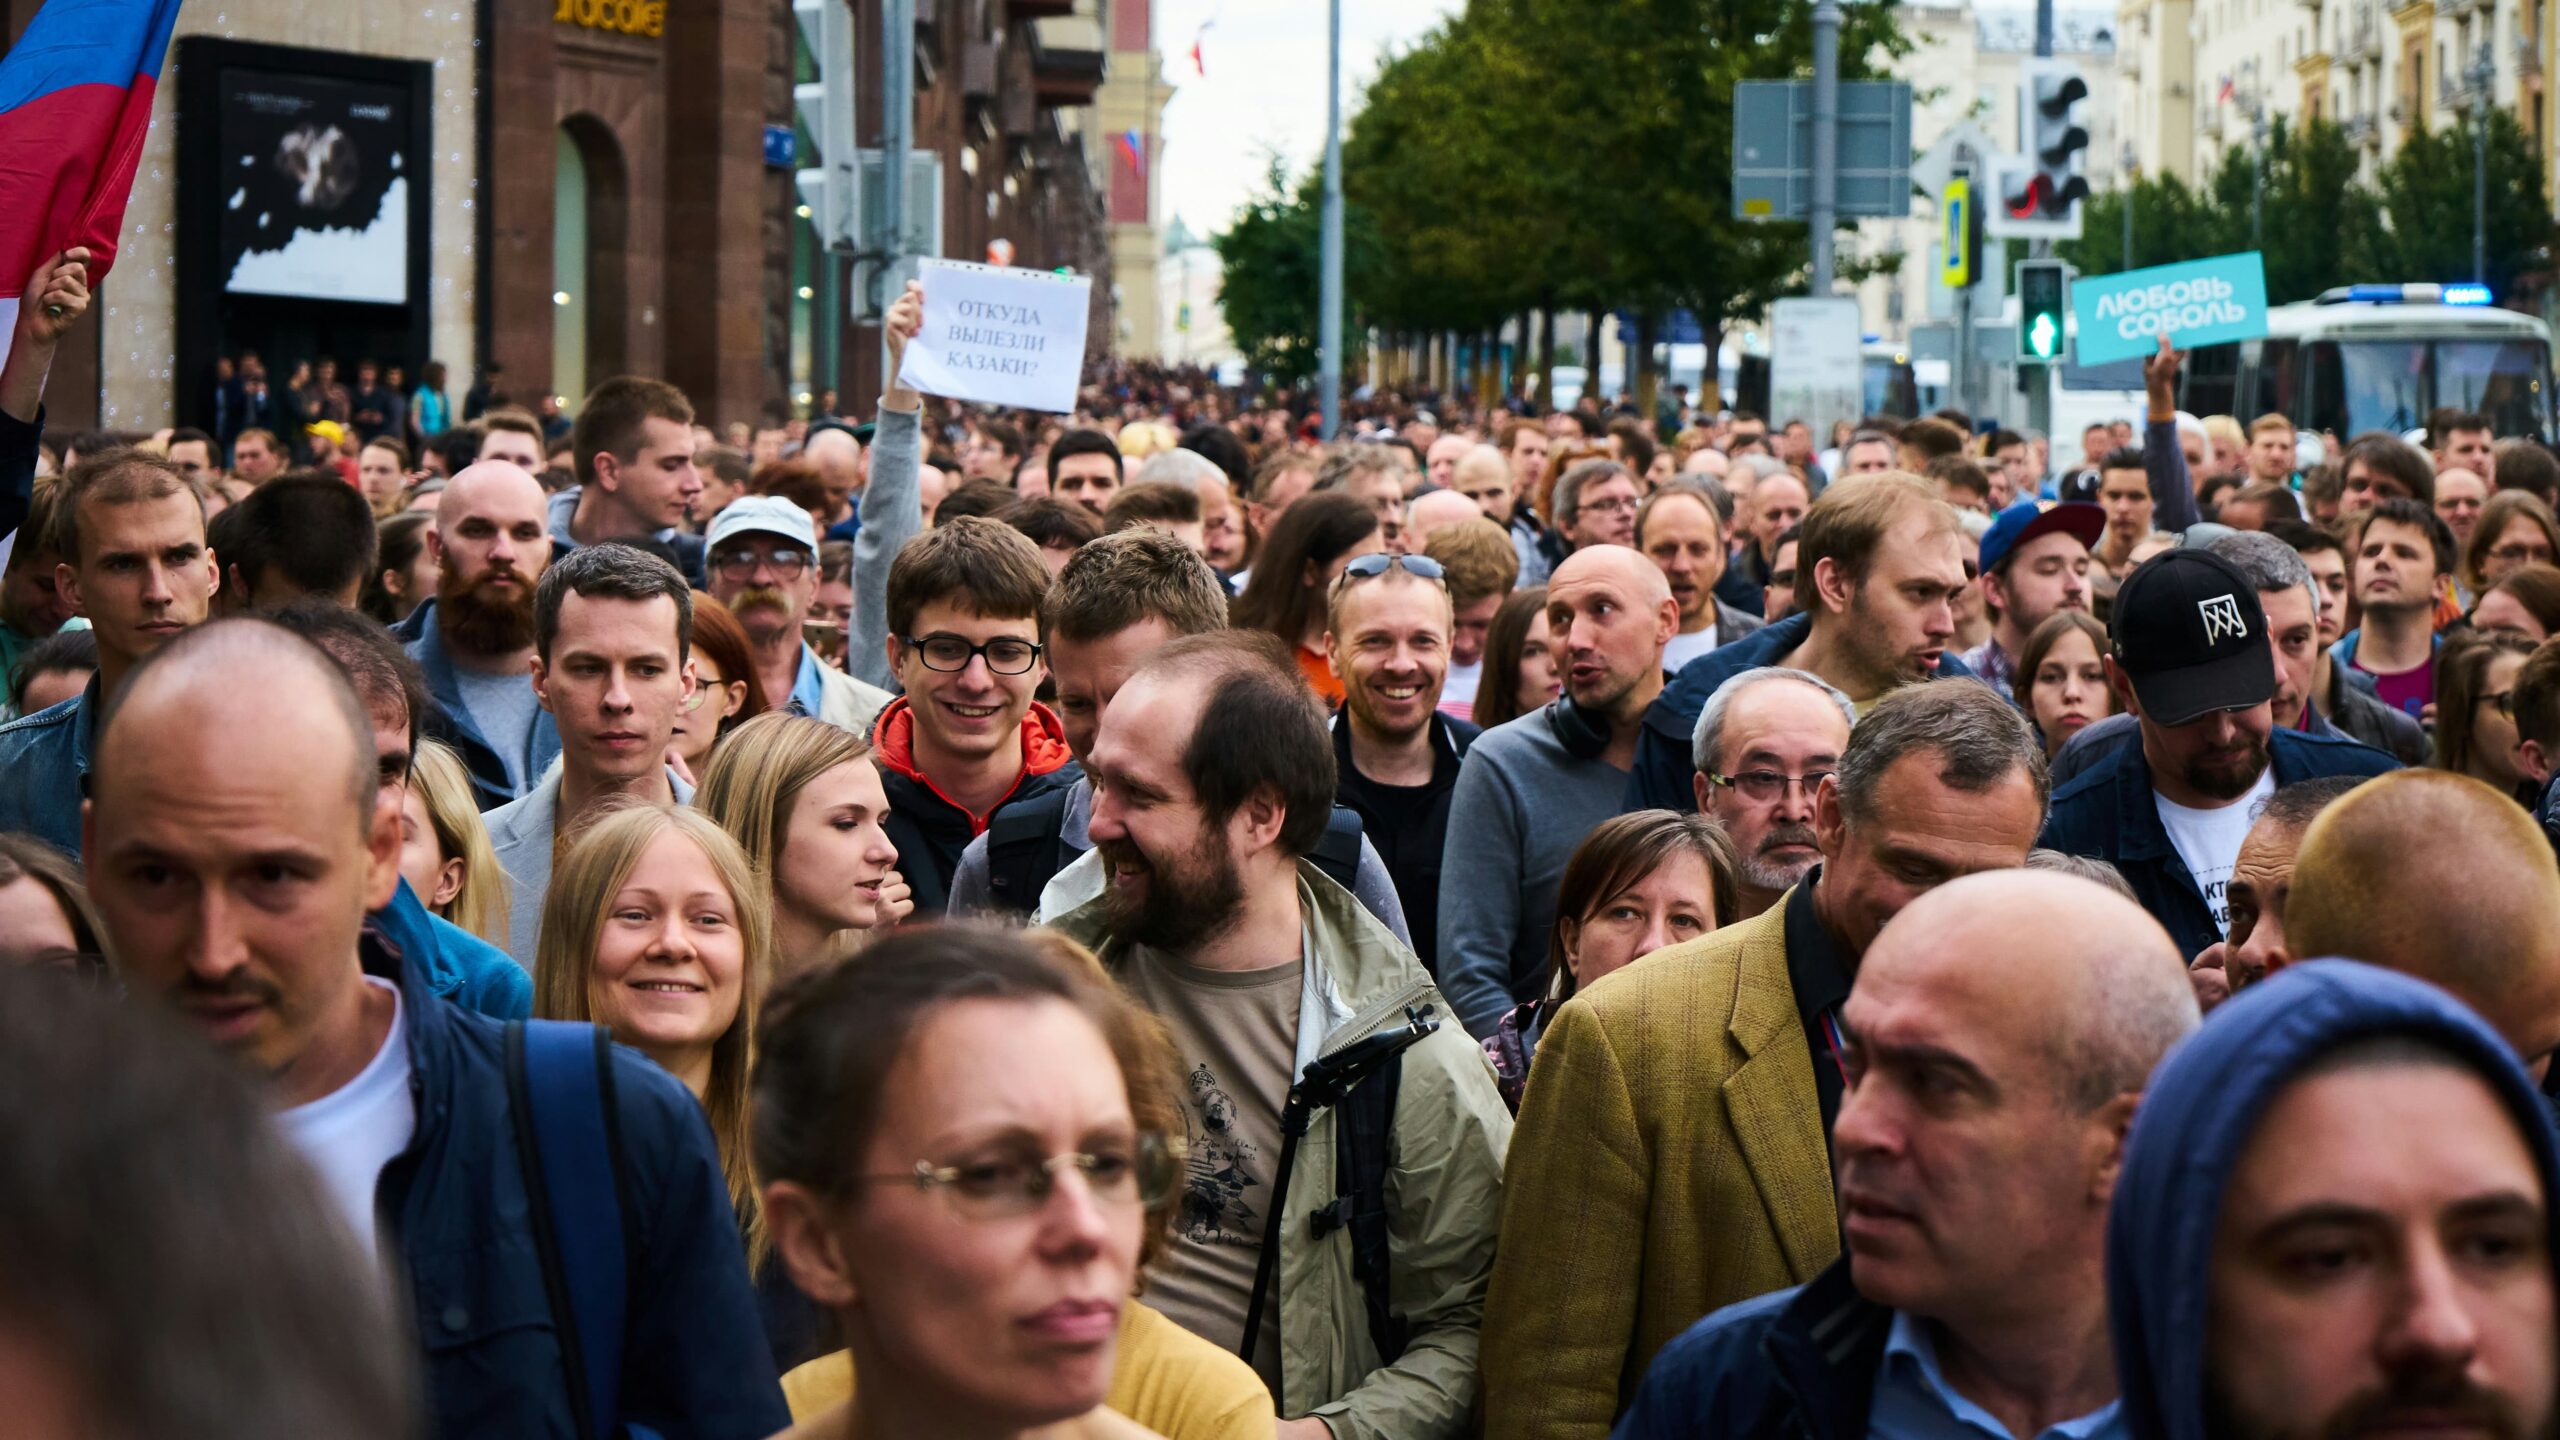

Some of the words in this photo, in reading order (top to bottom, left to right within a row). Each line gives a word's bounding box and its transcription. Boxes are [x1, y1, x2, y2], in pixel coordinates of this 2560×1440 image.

[2096, 277, 2233, 320] ЛЮБОВЬ
[958, 299, 1041, 326] ОТКУДА
[2117, 300, 2246, 340] СОБОЛЬ
[948, 325, 1045, 352] ВЫЛЕЗЛИ
[946, 351, 1038, 377] КАЗАКИ?
[2205, 879, 2232, 900] КТ
